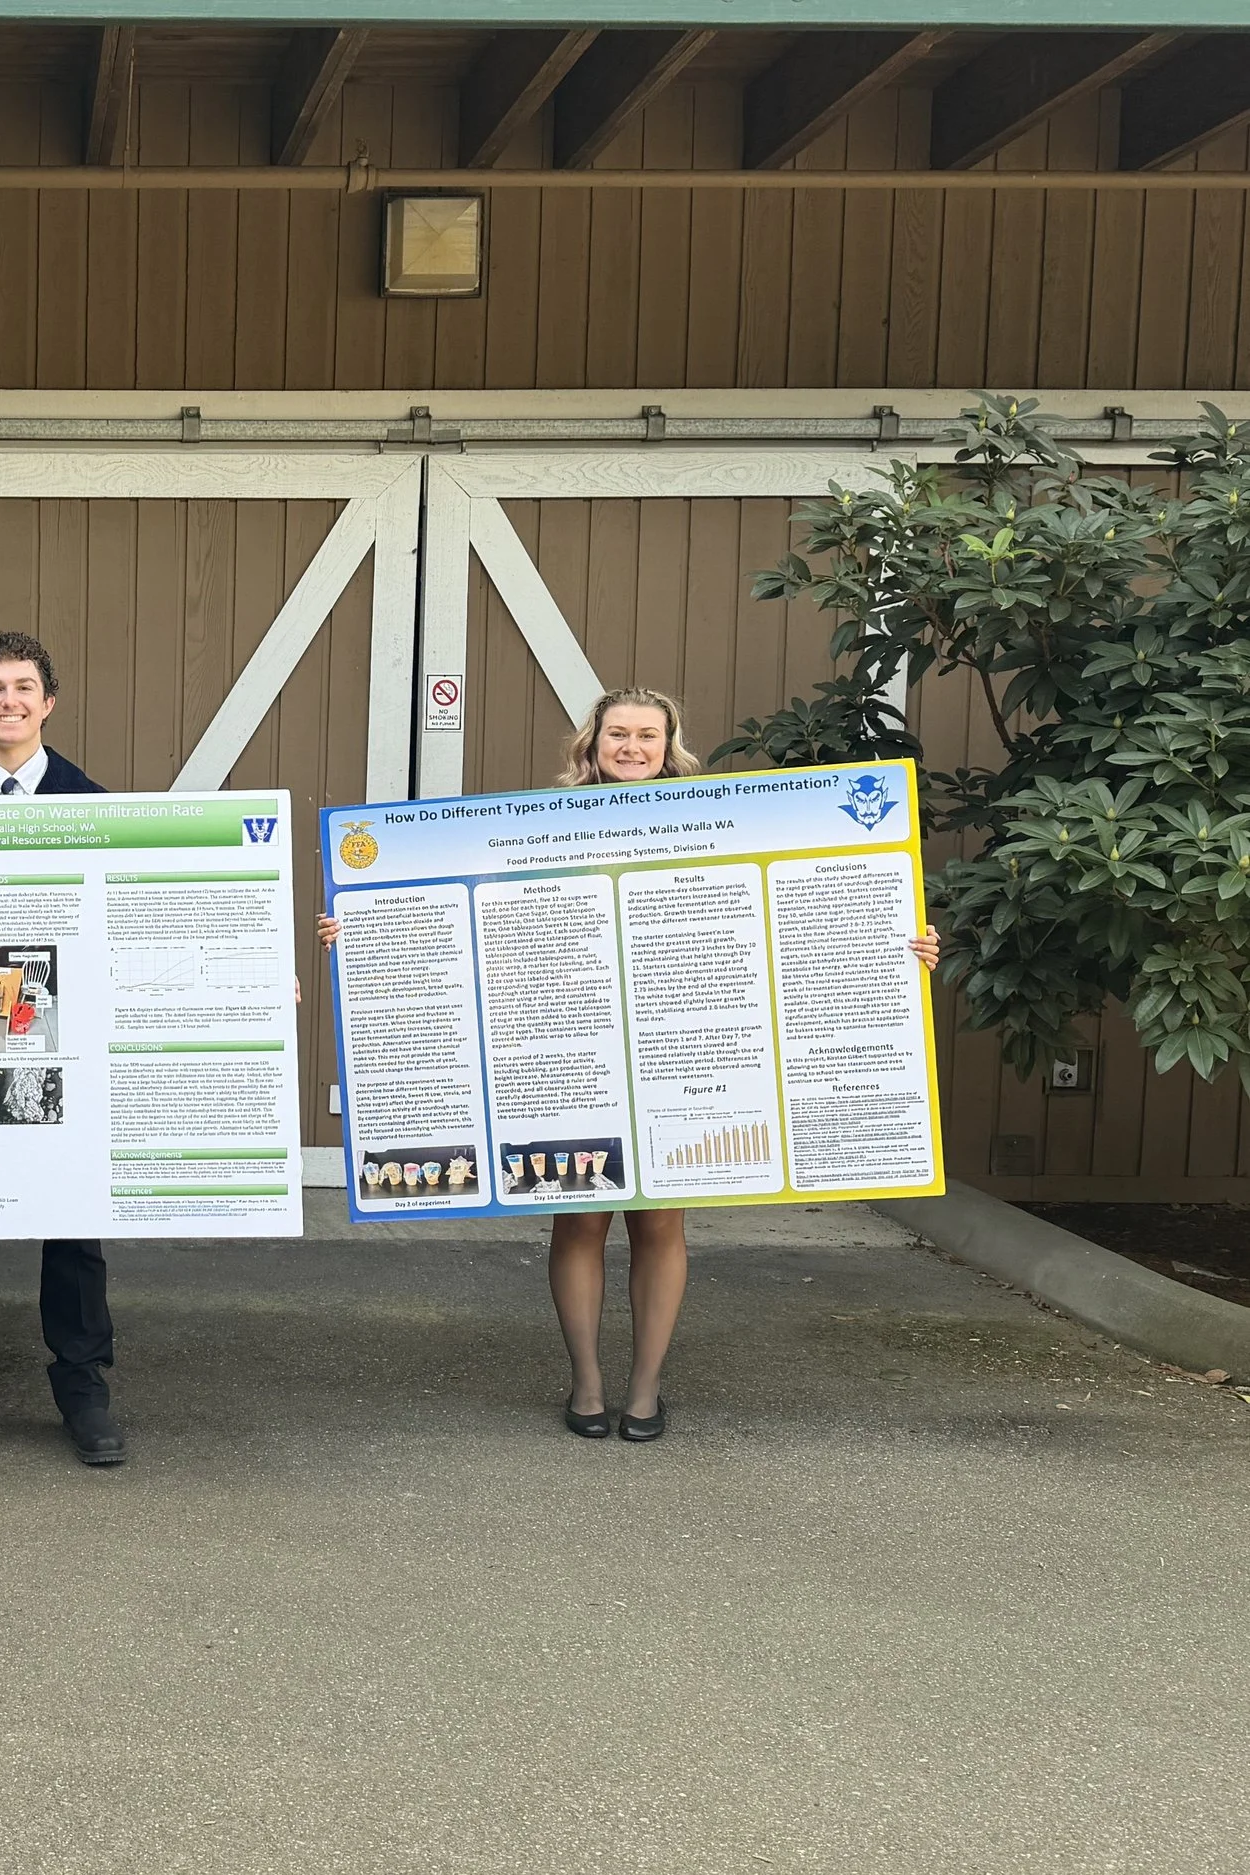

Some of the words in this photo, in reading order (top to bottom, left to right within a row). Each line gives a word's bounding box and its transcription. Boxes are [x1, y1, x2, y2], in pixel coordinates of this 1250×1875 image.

[385, 812, 414, 824] How
[419, 810, 437, 821] Do
[441, 804, 502, 819] Different
[505, 802, 544, 815] Types
[548, 797, 562, 810] of
[566, 797, 604, 810] Sugar
[608, 792, 650, 805] Affect
[654, 784, 730, 801] Sourdough
[735, 774, 838, 794] Fermentation?
[23, 806, 44, 819] On
[49, 806, 91, 818] Water
[96, 805, 167, 818] Infiltration
[172, 804, 203, 817] Rate
[18, 823, 40, 835] High
[42, 823, 77, 834] School,
[79, 822, 95, 832] WA
[488, 838, 523, 847] Gianna
[526, 833, 549, 844] Goff
[552, 832, 571, 842] and
[574, 830, 595, 840] Ellie
[598, 826, 646, 838] Edwards,
[648, 824, 678, 834] Walla
[681, 821, 711, 832] Walla
[714, 819, 734, 829] WA
[12, 835, 61, 845] Resources
[63, 834, 101, 844] Division
[104, 834, 110, 843] 5
[506, 856, 527, 865] Food
[529, 855, 566, 863] Products
[568, 852, 584, 860] and
[586, 849, 631, 859] Processing
[633, 847, 671, 856] Systems,
[673, 843, 707, 852] Division
[815, 862, 866, 873] Conclusions
[674, 874, 704, 883] Results
[523, 884, 560, 894] Methods
[374, 895, 425, 905] Introduction
[808, 1043, 893, 1054] Acknowledgements
[683, 1085, 712, 1095] Figure
[715, 1084, 726, 1092] #1
[832, 1083, 879, 1091] References
[112, 1151, 182, 1160] Acknowledgements
[562, 1193, 595, 1201] experiment
[418, 1199, 450, 1209] experiment
